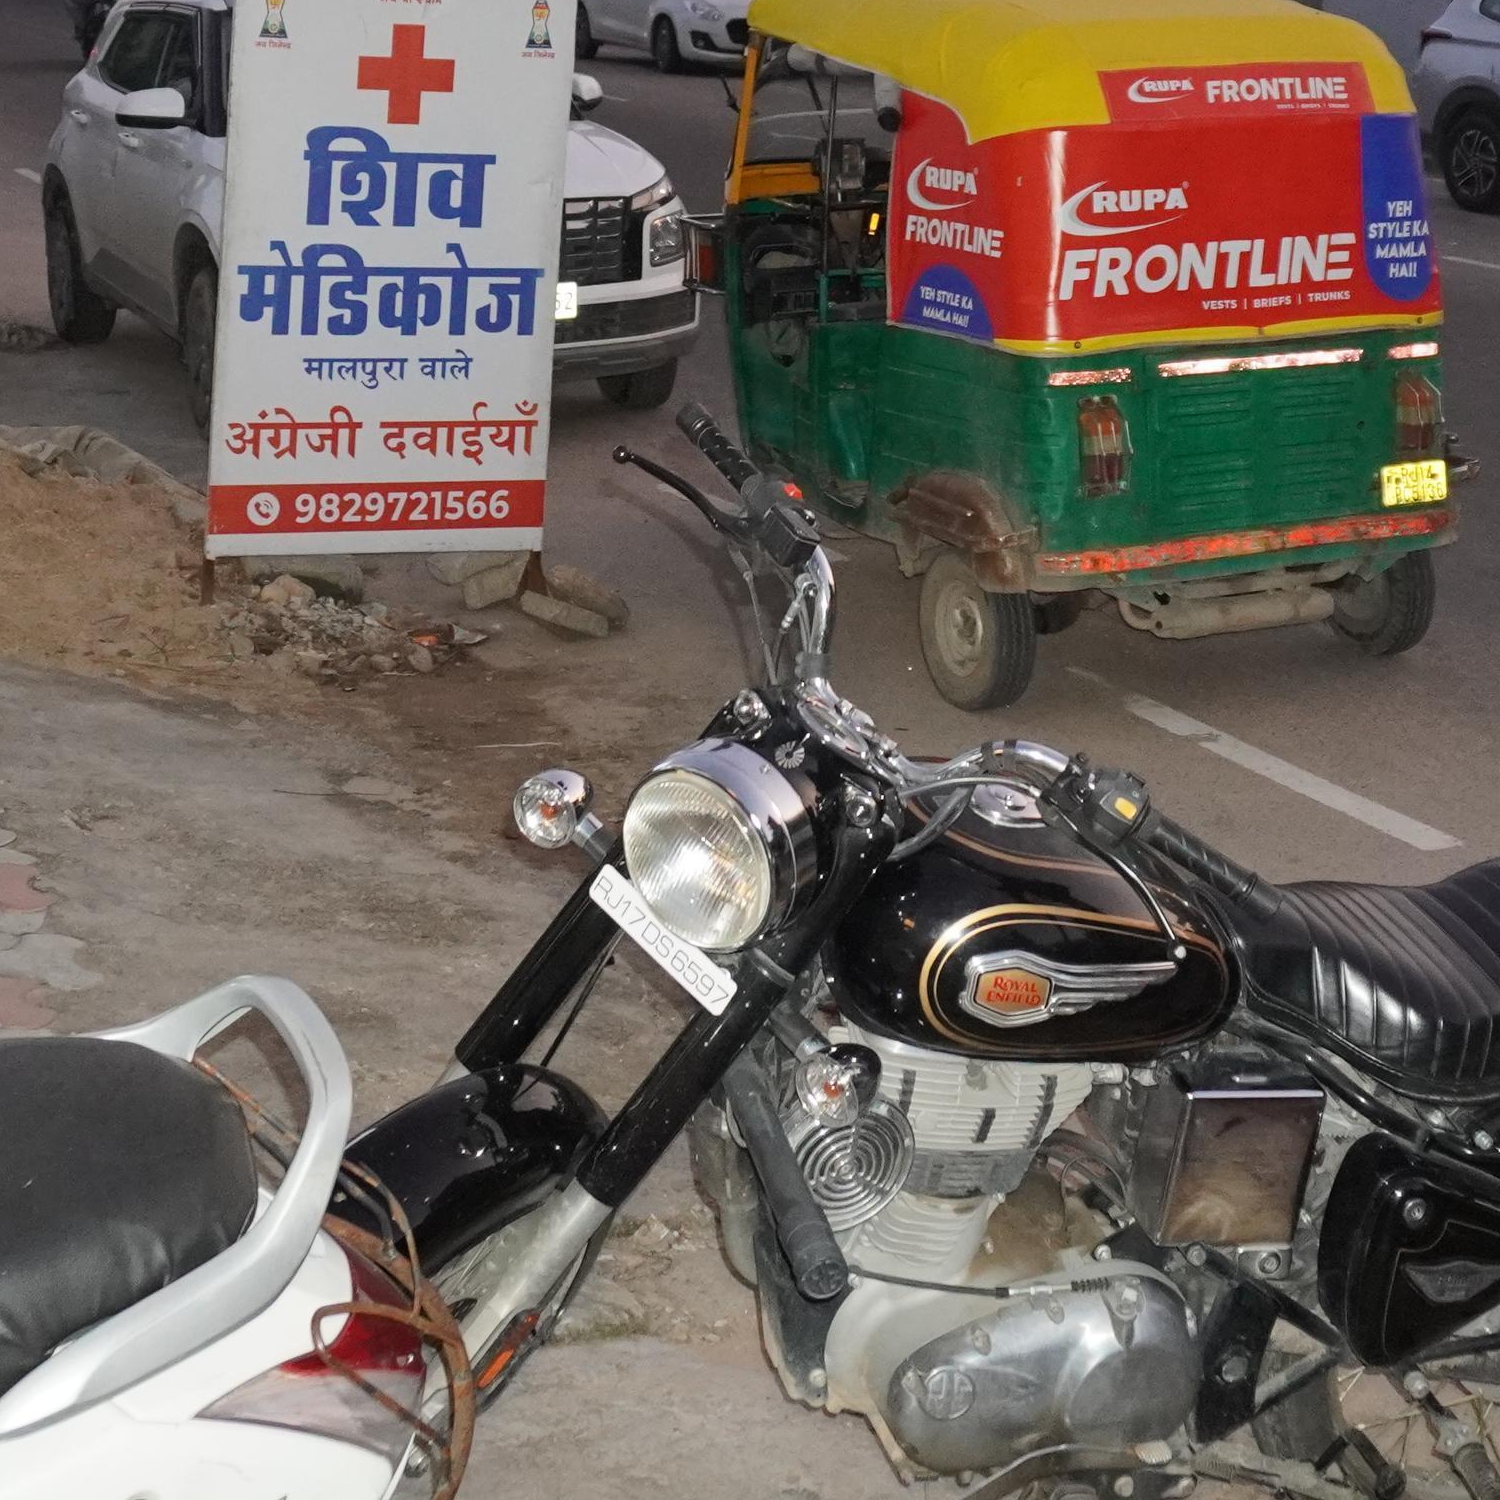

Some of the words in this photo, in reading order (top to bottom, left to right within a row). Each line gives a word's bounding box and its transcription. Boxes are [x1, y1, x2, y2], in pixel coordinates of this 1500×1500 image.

[1143, 79, 1194, 93] RUPA
[1206, 77, 1349, 103] FRONTLINE
[303, 126, 496, 229] शिव
[925, 166, 977, 195] RUPA
[1092, 187, 1189, 214] RUPA
[1387, 200, 1412, 217] YEH
[905, 214, 1004, 258] FRONTLINE
[1368, 221, 1411, 239] STYLE
[1412, 219, 1429, 237] KA
[1375, 241, 1427, 259] MAMLA
[1058, 232, 1357, 301] FRONTLINE
[237, 241, 545, 337] मेडिकोज
[920, 286, 935, 299] YEH
[936, 290, 959, 306] STYLE
[961, 296, 973, 310] KA
[1203, 299, 1238, 310] VESTS
[1253, 295, 1292, 309] BRIEFS
[1307, 290, 1351, 302] TRUNKS
[922, 306, 950, 323] MAMLA
[302, 357, 408, 390] मालपुरा
[419, 349, 473, 381] वाले
[225, 405, 363, 461] अंग्रेजी
[380, 402, 539, 466] दवाईयाँ
[295, 490, 510, 524] 9829721566
[993, 976, 1038, 992] ROYAL
[986, 989, 1041, 1008] ENFIELD
